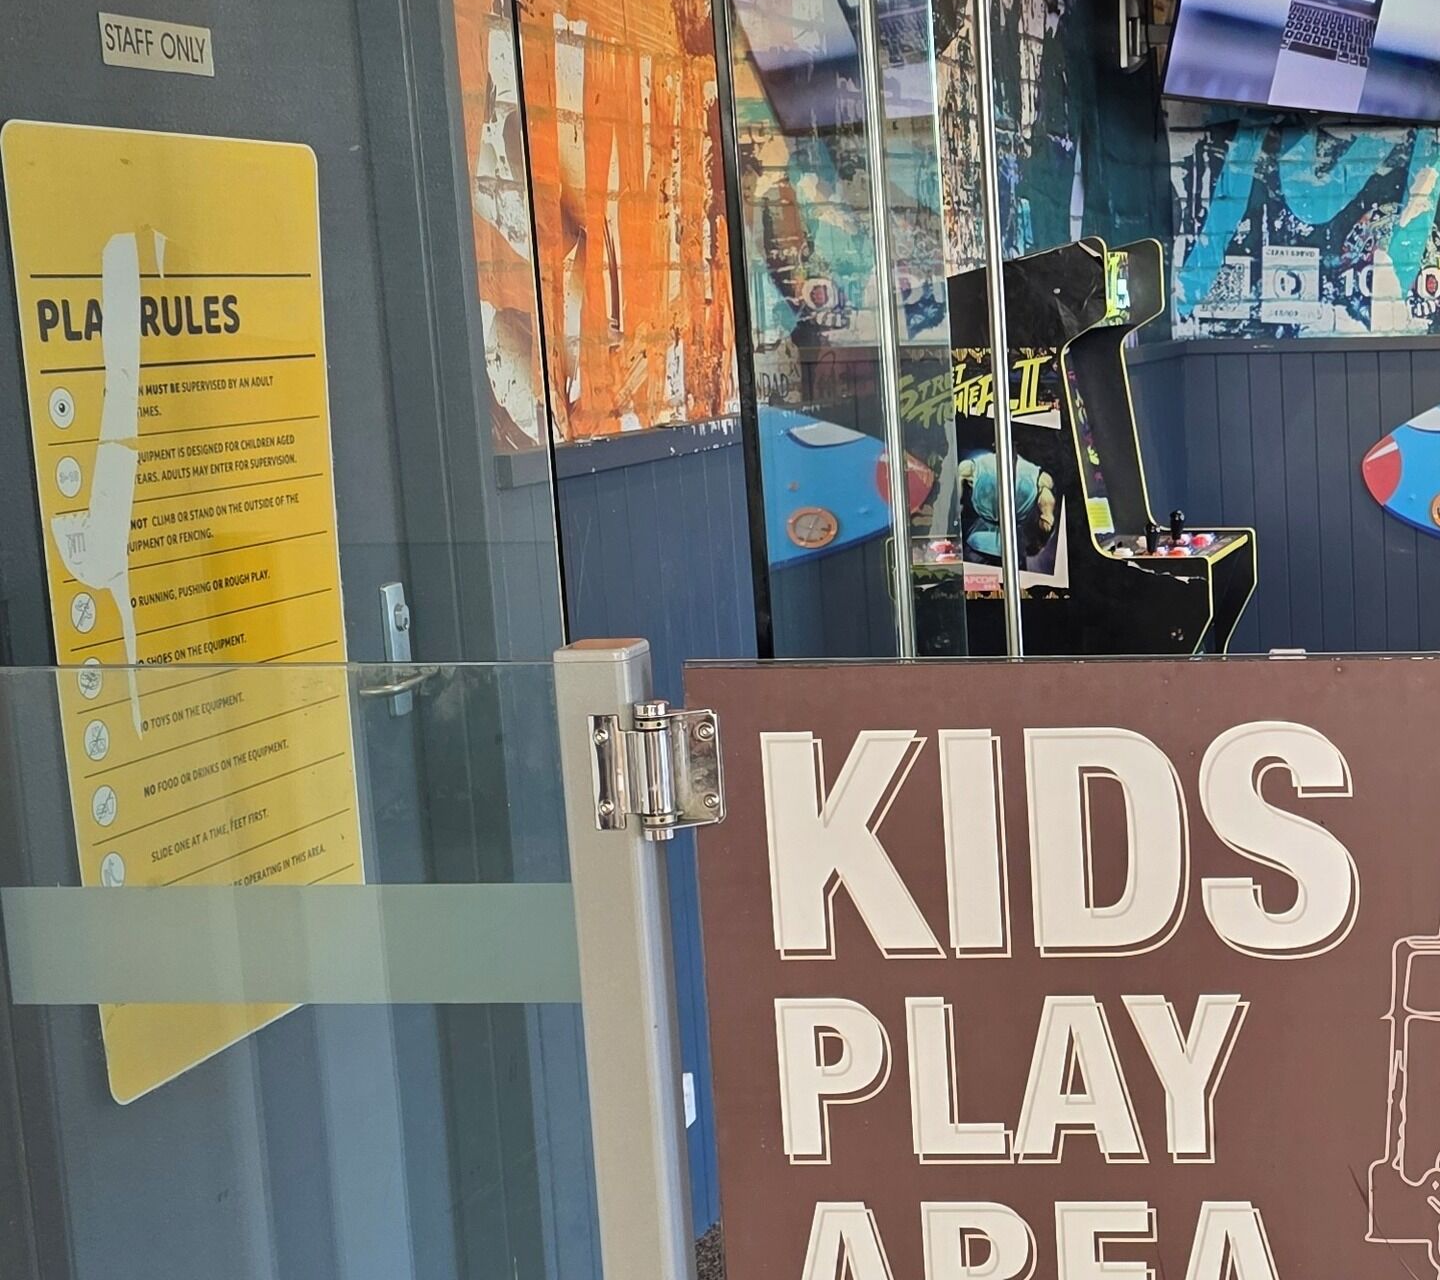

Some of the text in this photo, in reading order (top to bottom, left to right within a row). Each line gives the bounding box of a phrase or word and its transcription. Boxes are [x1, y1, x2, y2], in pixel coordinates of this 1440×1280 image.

[105, 23, 205, 64] STAFF ONLY
[37, 294, 240, 342] PLA RULES
[146, 383, 168, 395] MUST
[170, 382, 180, 393] BE
[182, 379, 226, 393] SUPERVISED
[228, 378, 237, 389] BY
[239, 377, 250, 388] AN
[251, 375, 273, 387] ADULT
[177, 447, 185, 458] IS
[187, 443, 224, 457] DESIGNED
[225, 442, 239, 454] FOR
[241, 437, 275, 452] CHILDREN
[276, 435, 295, 448] AGED
[162, 468, 191, 481] ADULTS
[192, 466, 208, 478] MAY
[210, 462, 234, 476] ENTER
[235, 459, 249, 472] FOR
[250, 454, 297, 470] SUPERVISION.
[130, 493, 300, 530] NOT CLIMB OR STAND ON THE OUTSIDE OF THE
[166, 533, 178, 546] OR
[179, 528, 214, 543] FENCING.
[139, 589, 177, 607] RUNNING,
[178, 581, 212, 598] PUSHING
[212, 579, 223, 590] OR
[225, 575, 250, 588] ROUGH
[251, 569, 270, 582] PLAY.
[174, 649, 186, 661] ON
[188, 644, 202, 656] THE
[203, 633, 247, 654] EQUIPMENT.
[151, 714, 170, 729] TOYS
[172, 711, 183, 723] ON
[185, 707, 200, 719] THE
[201, 692, 244, 715] EQUIPMENT.
[144, 739, 289, 798] NO FOOD OR DRINKS ON THE EQUIPMENT.
[151, 844, 173, 863] SLIDE
[174, 838, 190, 854] ONE
[192, 834, 201, 848] AT
[203, 832, 208, 842] A
[759, 720, 1361, 961] KIDS
[244, 862, 282, 887] OPERATING
[283, 857, 291, 869] IN
[291, 851, 307, 867] THIS
[773, 993, 1252, 1166] PLAY
